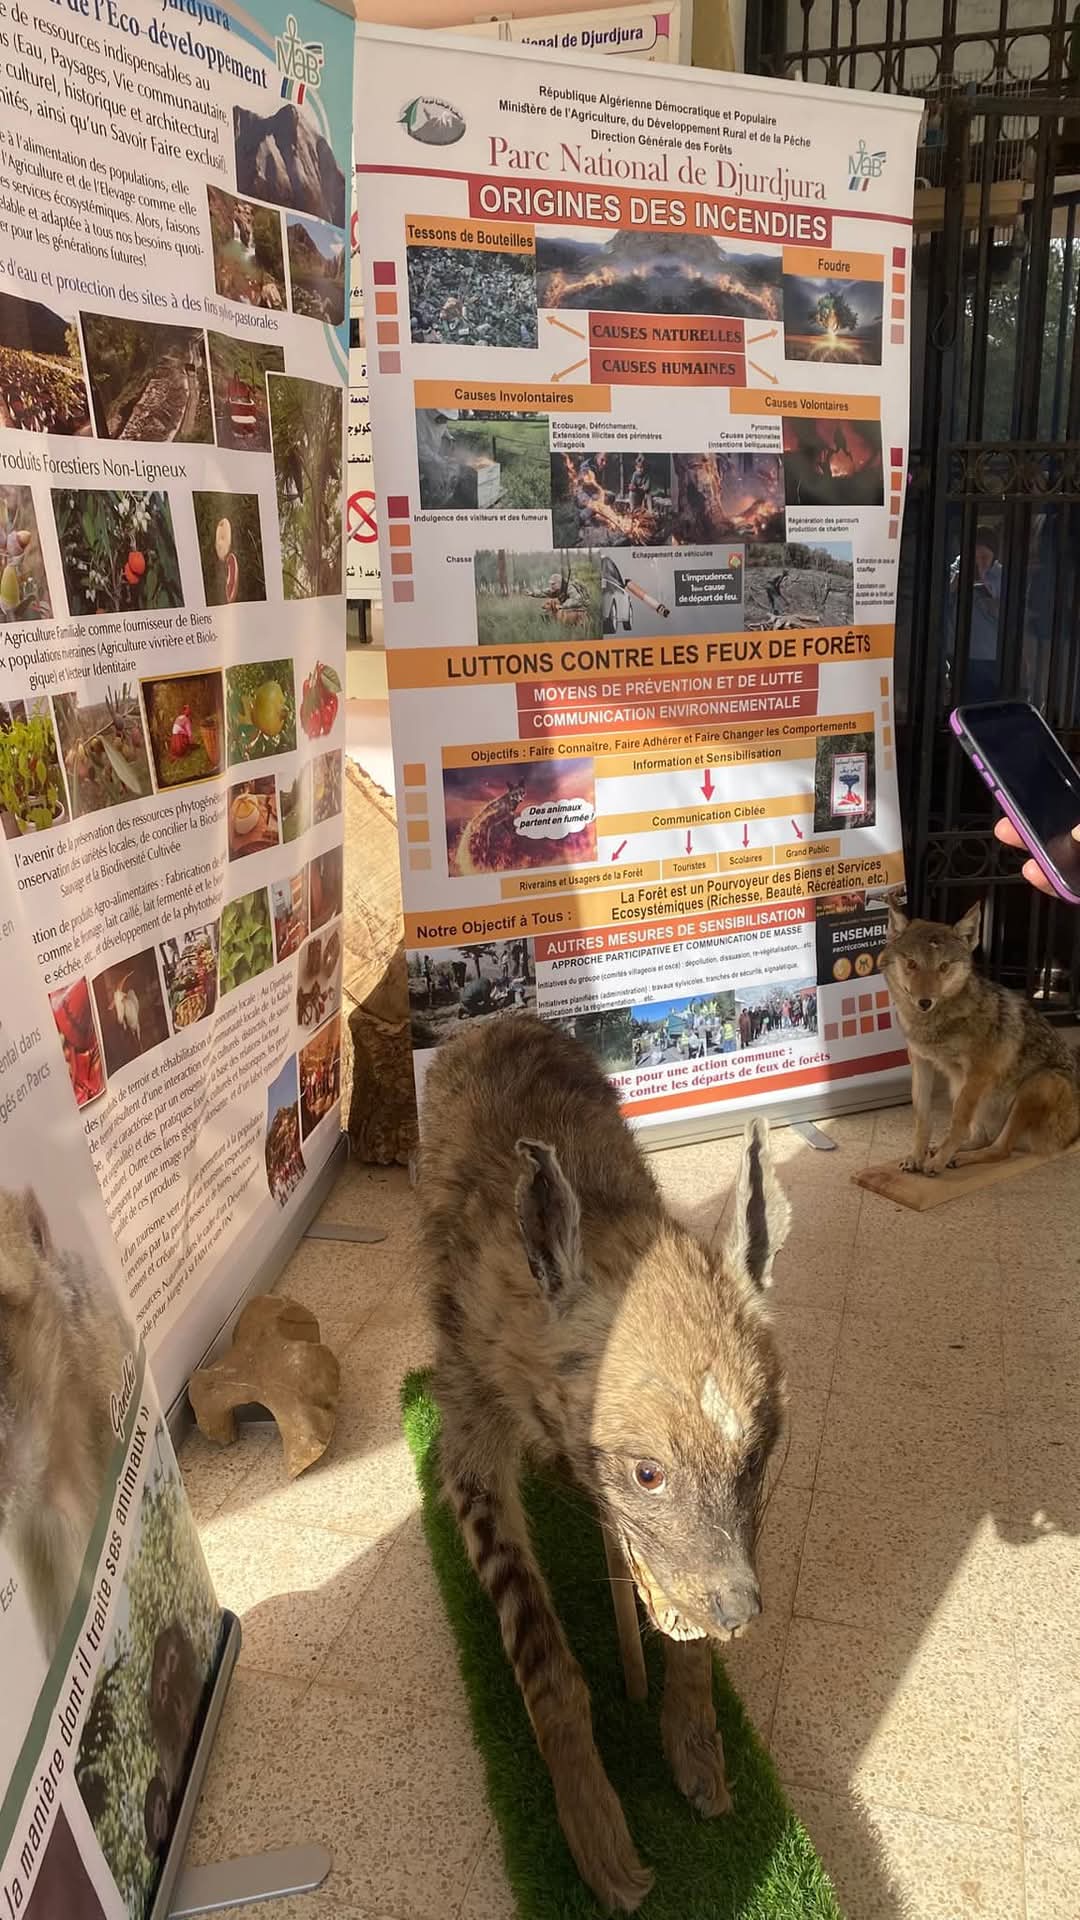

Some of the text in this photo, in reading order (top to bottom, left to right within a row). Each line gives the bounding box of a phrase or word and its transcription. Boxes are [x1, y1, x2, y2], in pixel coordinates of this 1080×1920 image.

[11, 3, 28, 26] de
[33, 16, 100, 53] ressources
[104, 40, 191, 86] indispensables
[195, 76, 210, 91] au
[562, 34, 577, 48] de
[581, 26, 643, 48] Djurdjura
[13, 33, 229, 126] (Eau, Paysages, Vie communautaire,
[5, 62, 219, 144] culturel, historique et architectural
[539, 85, 777, 127] République Algérienne Démocratique et Populaire
[37, 100, 182, 158] ainsi qu'un Savoir Faire
[499, 99, 811, 148] Ministère de l'Agriculture, du Développement Rural et de la Pêche
[591, 129, 733, 155] Direction Générale des Forêts
[488, 136, 827, 201] Parc National de Djurdjura
[66, 173, 76, 188] et
[78, 176, 92, 192] de
[138, 194, 176, 212] comme
[178, 200, 197, 217] elle
[479, 184, 828, 241] ORIGINES DES INCENDIES
[408, 225, 534, 248] Tessons de Bouteilles
[818, 258, 851, 272] Foudre
[592, 325, 743, 344] CAUSES NATURELLES
[602, 359, 736, 375] CAUSES HUMAINES
[454, 388, 574, 404] Causes Involontaires
[765, 396, 849, 412] Causes Volontaires
[42, 453, 187, 483] Forestiers Non-Ligneux
[446, 554, 472, 564] Chasse
[87, 622, 121, 636] comme
[123, 616, 172, 633] fournisseur
[175, 614, 188, 627] de
[190, 612, 213, 626] Biens
[447, 631, 871, 678] LUTTONS CONTRE LES FEUX DE FORÊTS
[534, 671, 803, 702] MOYENS DE PRÉVENTION ET DE LUTTE
[533, 696, 801, 728] COMMUNICATION ENVIRONNEMENTALE
[471, 748, 519, 763] Objectifs
[529, 745, 555, 758] Faire
[615, 737, 640, 749] Faire
[643, 733, 682, 747] Adhérer
[683, 733, 693, 744] et
[695, 730, 720, 742] Faire
[723, 727, 764, 742] Changer
[766, 725, 780, 736] les
[782, 720, 857, 735] Comportements
[633, 748, 782, 770] Information et Sensibilisation
[651, 805, 766, 827] Communication Ciblée
[147, 843, 181, 861] Cultivée
[611, 871, 889, 920] Ecosystémiques (Richesse, Beauté, Récréation, etc.)
[621, 859, 881, 904] La Forêt est un Pourvoyeur des Biens et Services
[101, 917, 160, 953] développement
[416, 909, 564, 940] Notre Objectif à Tous
[547, 935, 604, 955] AUTRES
[608, 924, 674, 946] MESURES
[677, 921, 697, 937] DE
[698, 907, 806, 933] SENSIBILISATION
[552, 926, 803, 970] APPROCHE PARTICIPATIVE ET COMMUNICATION DE MASSE
[630, 1051, 831, 1098] contre les départs de feux de forêts
[635, 1050, 786, 1088] pour une action commune
[4, 1426, 148, 1920] la manière dont il traite ses animaux
